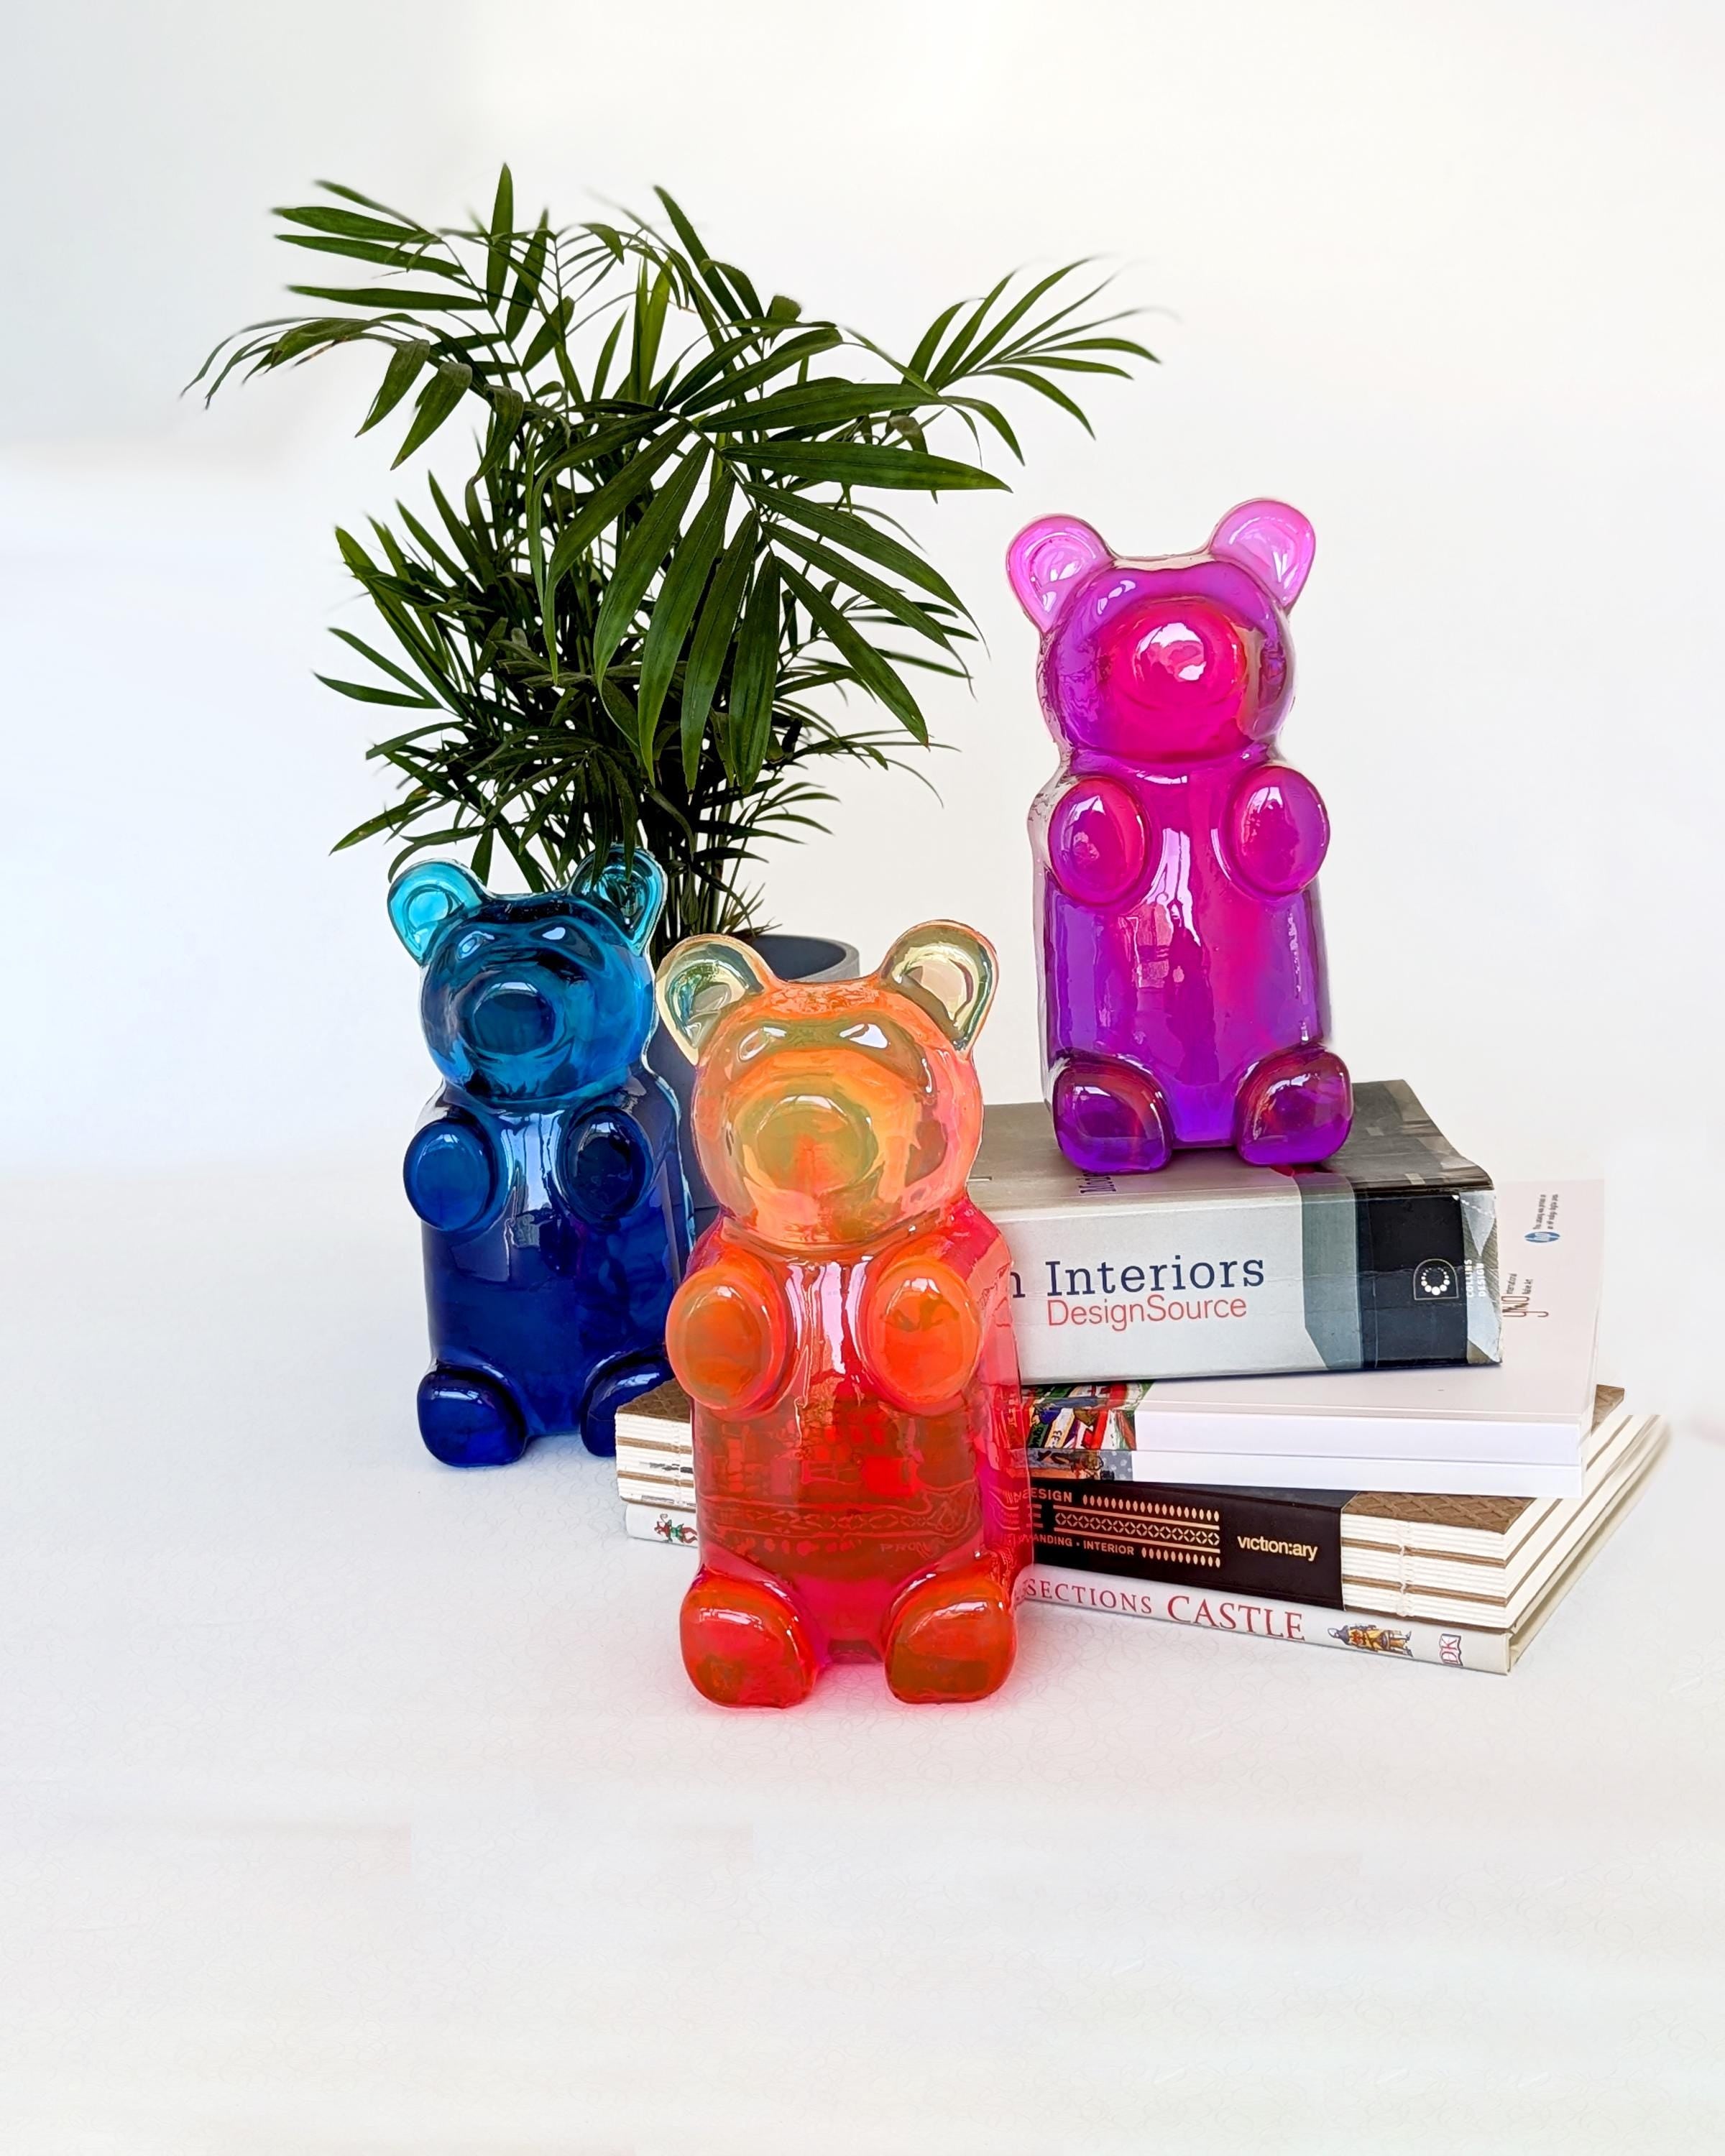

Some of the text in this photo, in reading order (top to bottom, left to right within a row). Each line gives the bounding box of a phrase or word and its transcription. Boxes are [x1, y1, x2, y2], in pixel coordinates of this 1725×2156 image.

[1045, 1255, 1264, 1296] Interiors
[1464, 1259, 1473, 1298] COLLINS
[1476, 1263, 1486, 1298] DESIGN
[1047, 1294, 1247, 1332] DesignSource
[1083, 1540, 1135, 1556] INTERIOR
[1167, 1595, 1305, 1641] CASTLE
[1440, 1636, 1459, 1664] DK
